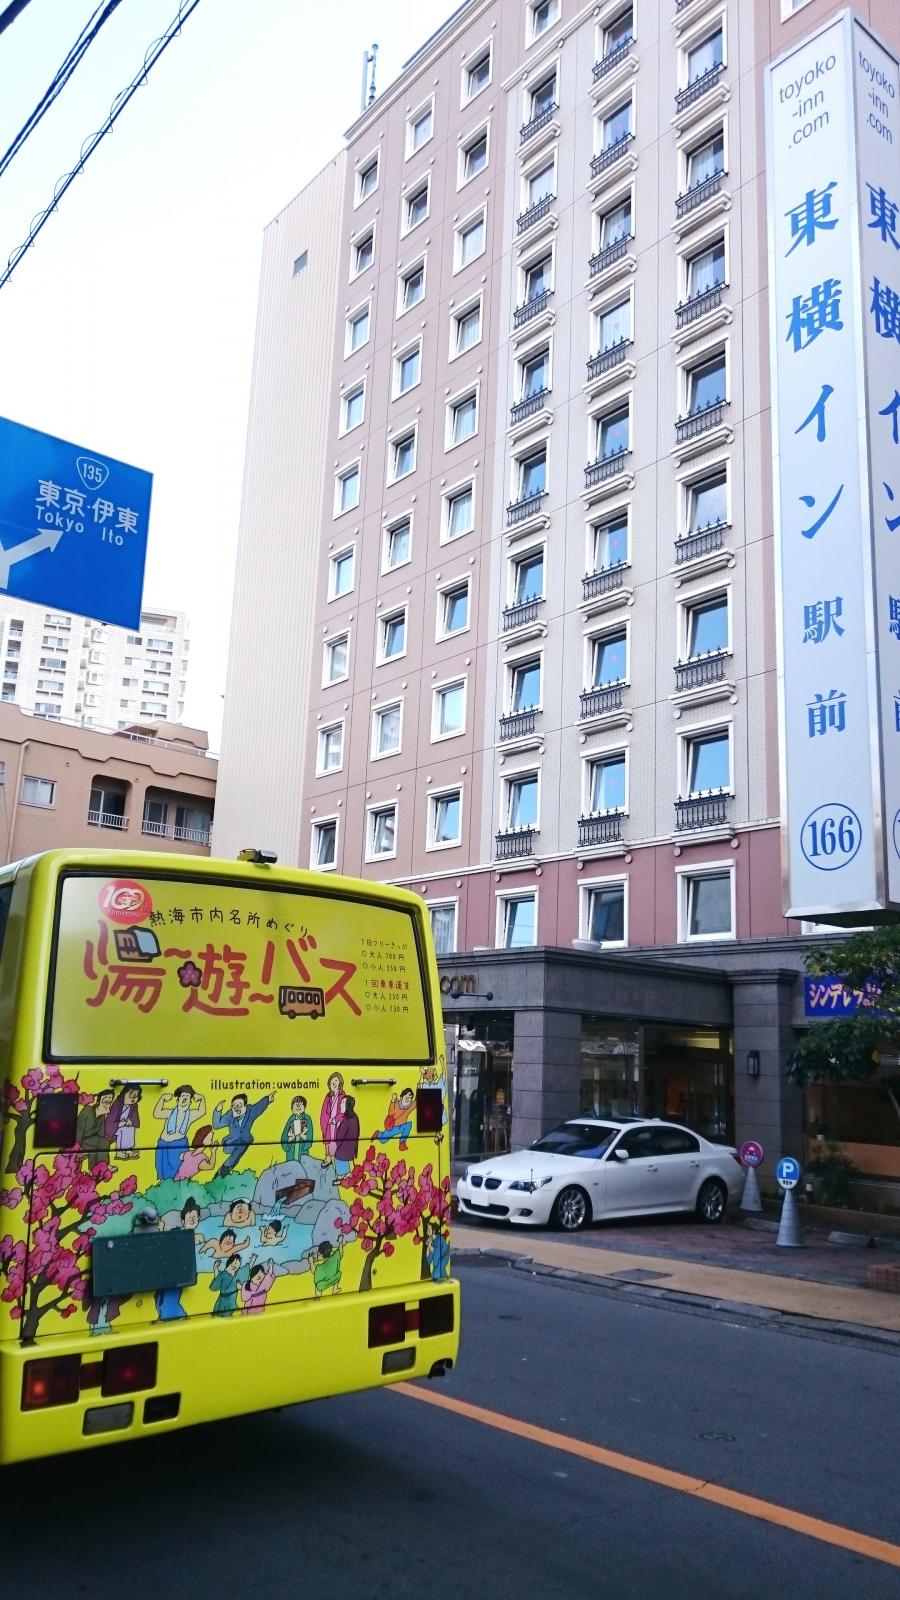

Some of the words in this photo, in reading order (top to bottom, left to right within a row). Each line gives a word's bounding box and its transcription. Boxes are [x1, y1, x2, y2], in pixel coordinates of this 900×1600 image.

[779, 55, 836, 103] toyoko
[858, 50, 895, 99] toyoko
[792, 90, 824, 118] -inn
[868, 87, 889, 118] -inn
[788, 111, 829, 149] .com
[866, 112, 893, 145] .com
[82, 463, 103, 483] 135
[35, 505, 84, 533] Tokyo
[101, 527, 124, 546] Ito
[808, 815, 855, 857] 166
[149, 907, 309, 938] 熱海市内名所めぐり
[782, 1162, 795, 1178] P
